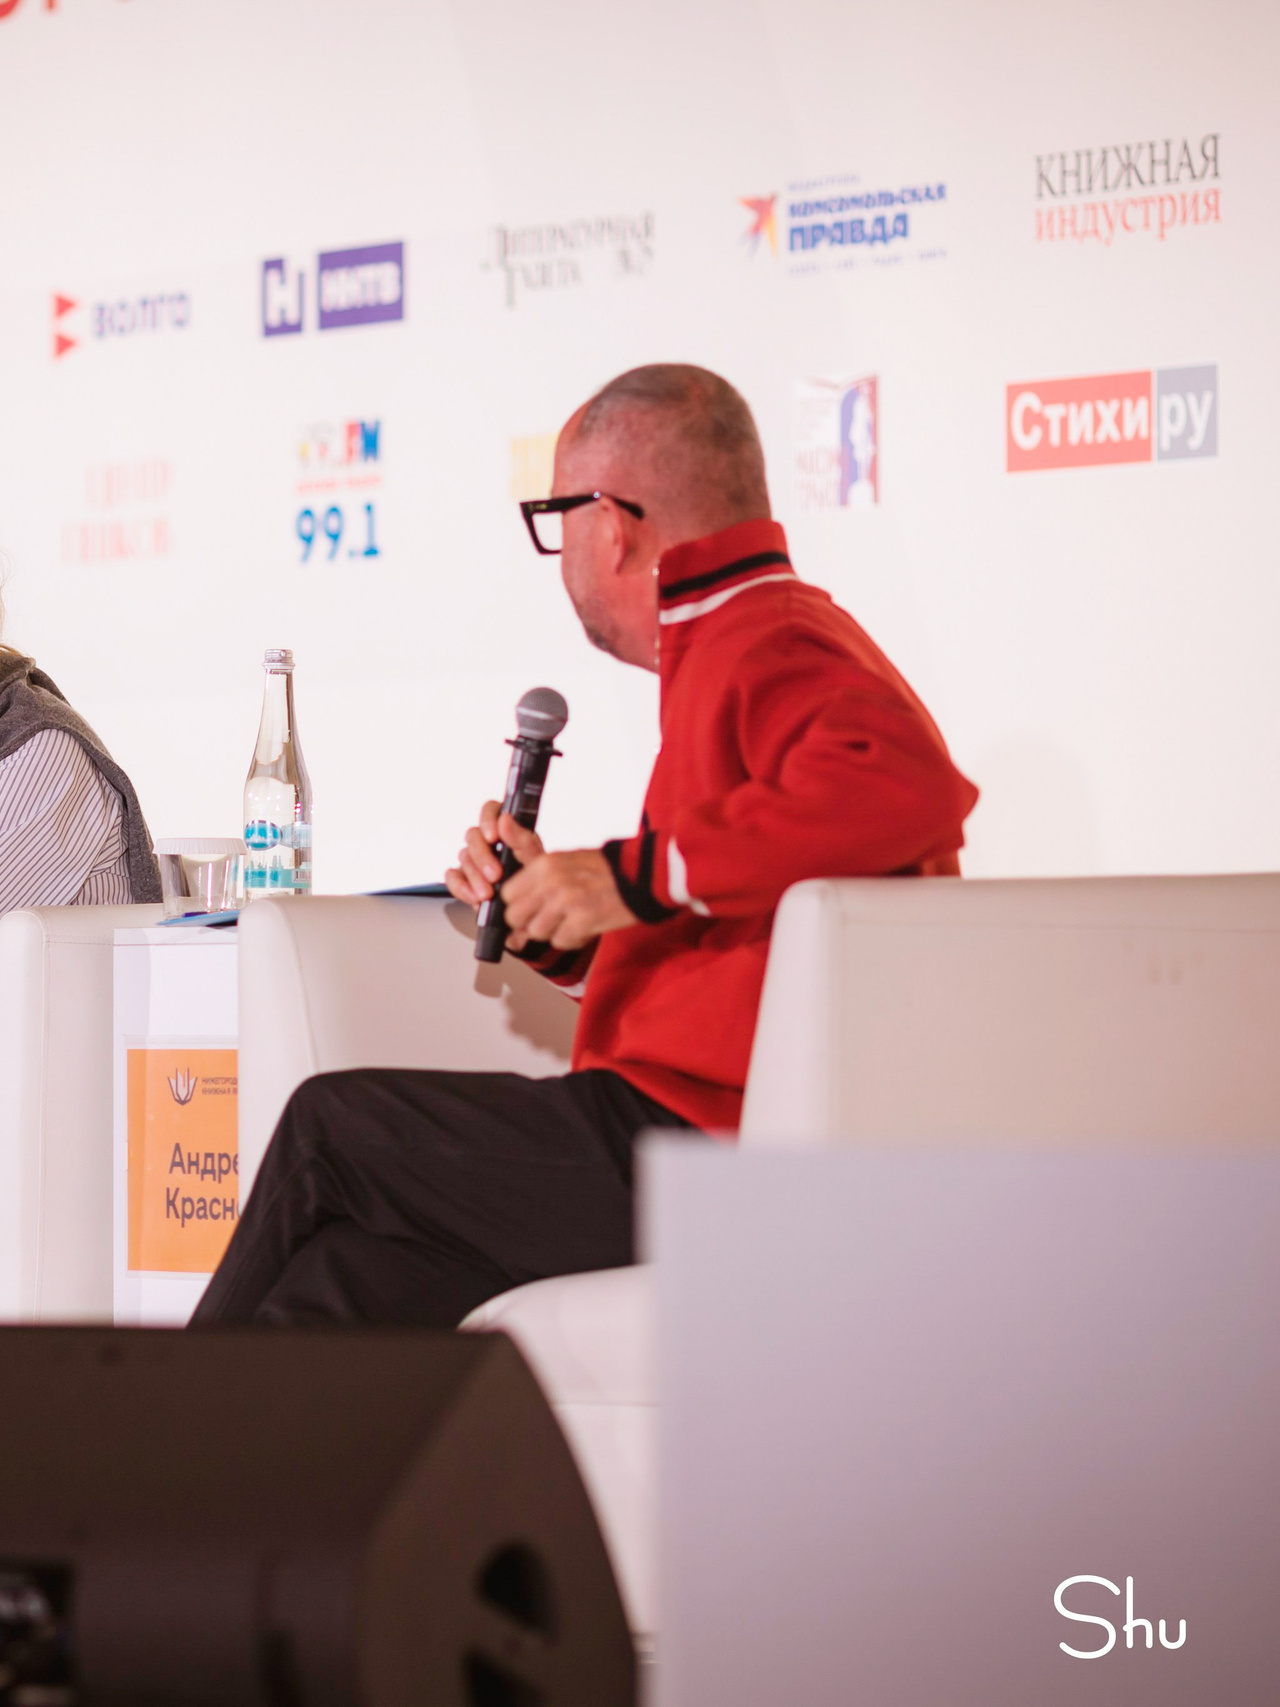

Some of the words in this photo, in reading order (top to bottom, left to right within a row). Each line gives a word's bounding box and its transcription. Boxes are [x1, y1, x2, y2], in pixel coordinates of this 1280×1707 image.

[1034, 131, 1220, 200] КНИЖНАЯ
[789, 212, 908, 252] ПРАВДА
[1033, 187, 1220, 247] индустрия
[1011, 391, 1150, 451] Стихи
[1158, 389, 1215, 452] ру
[295, 503, 379, 562] 99.1
[165, 1187, 240, 1228] Красн
